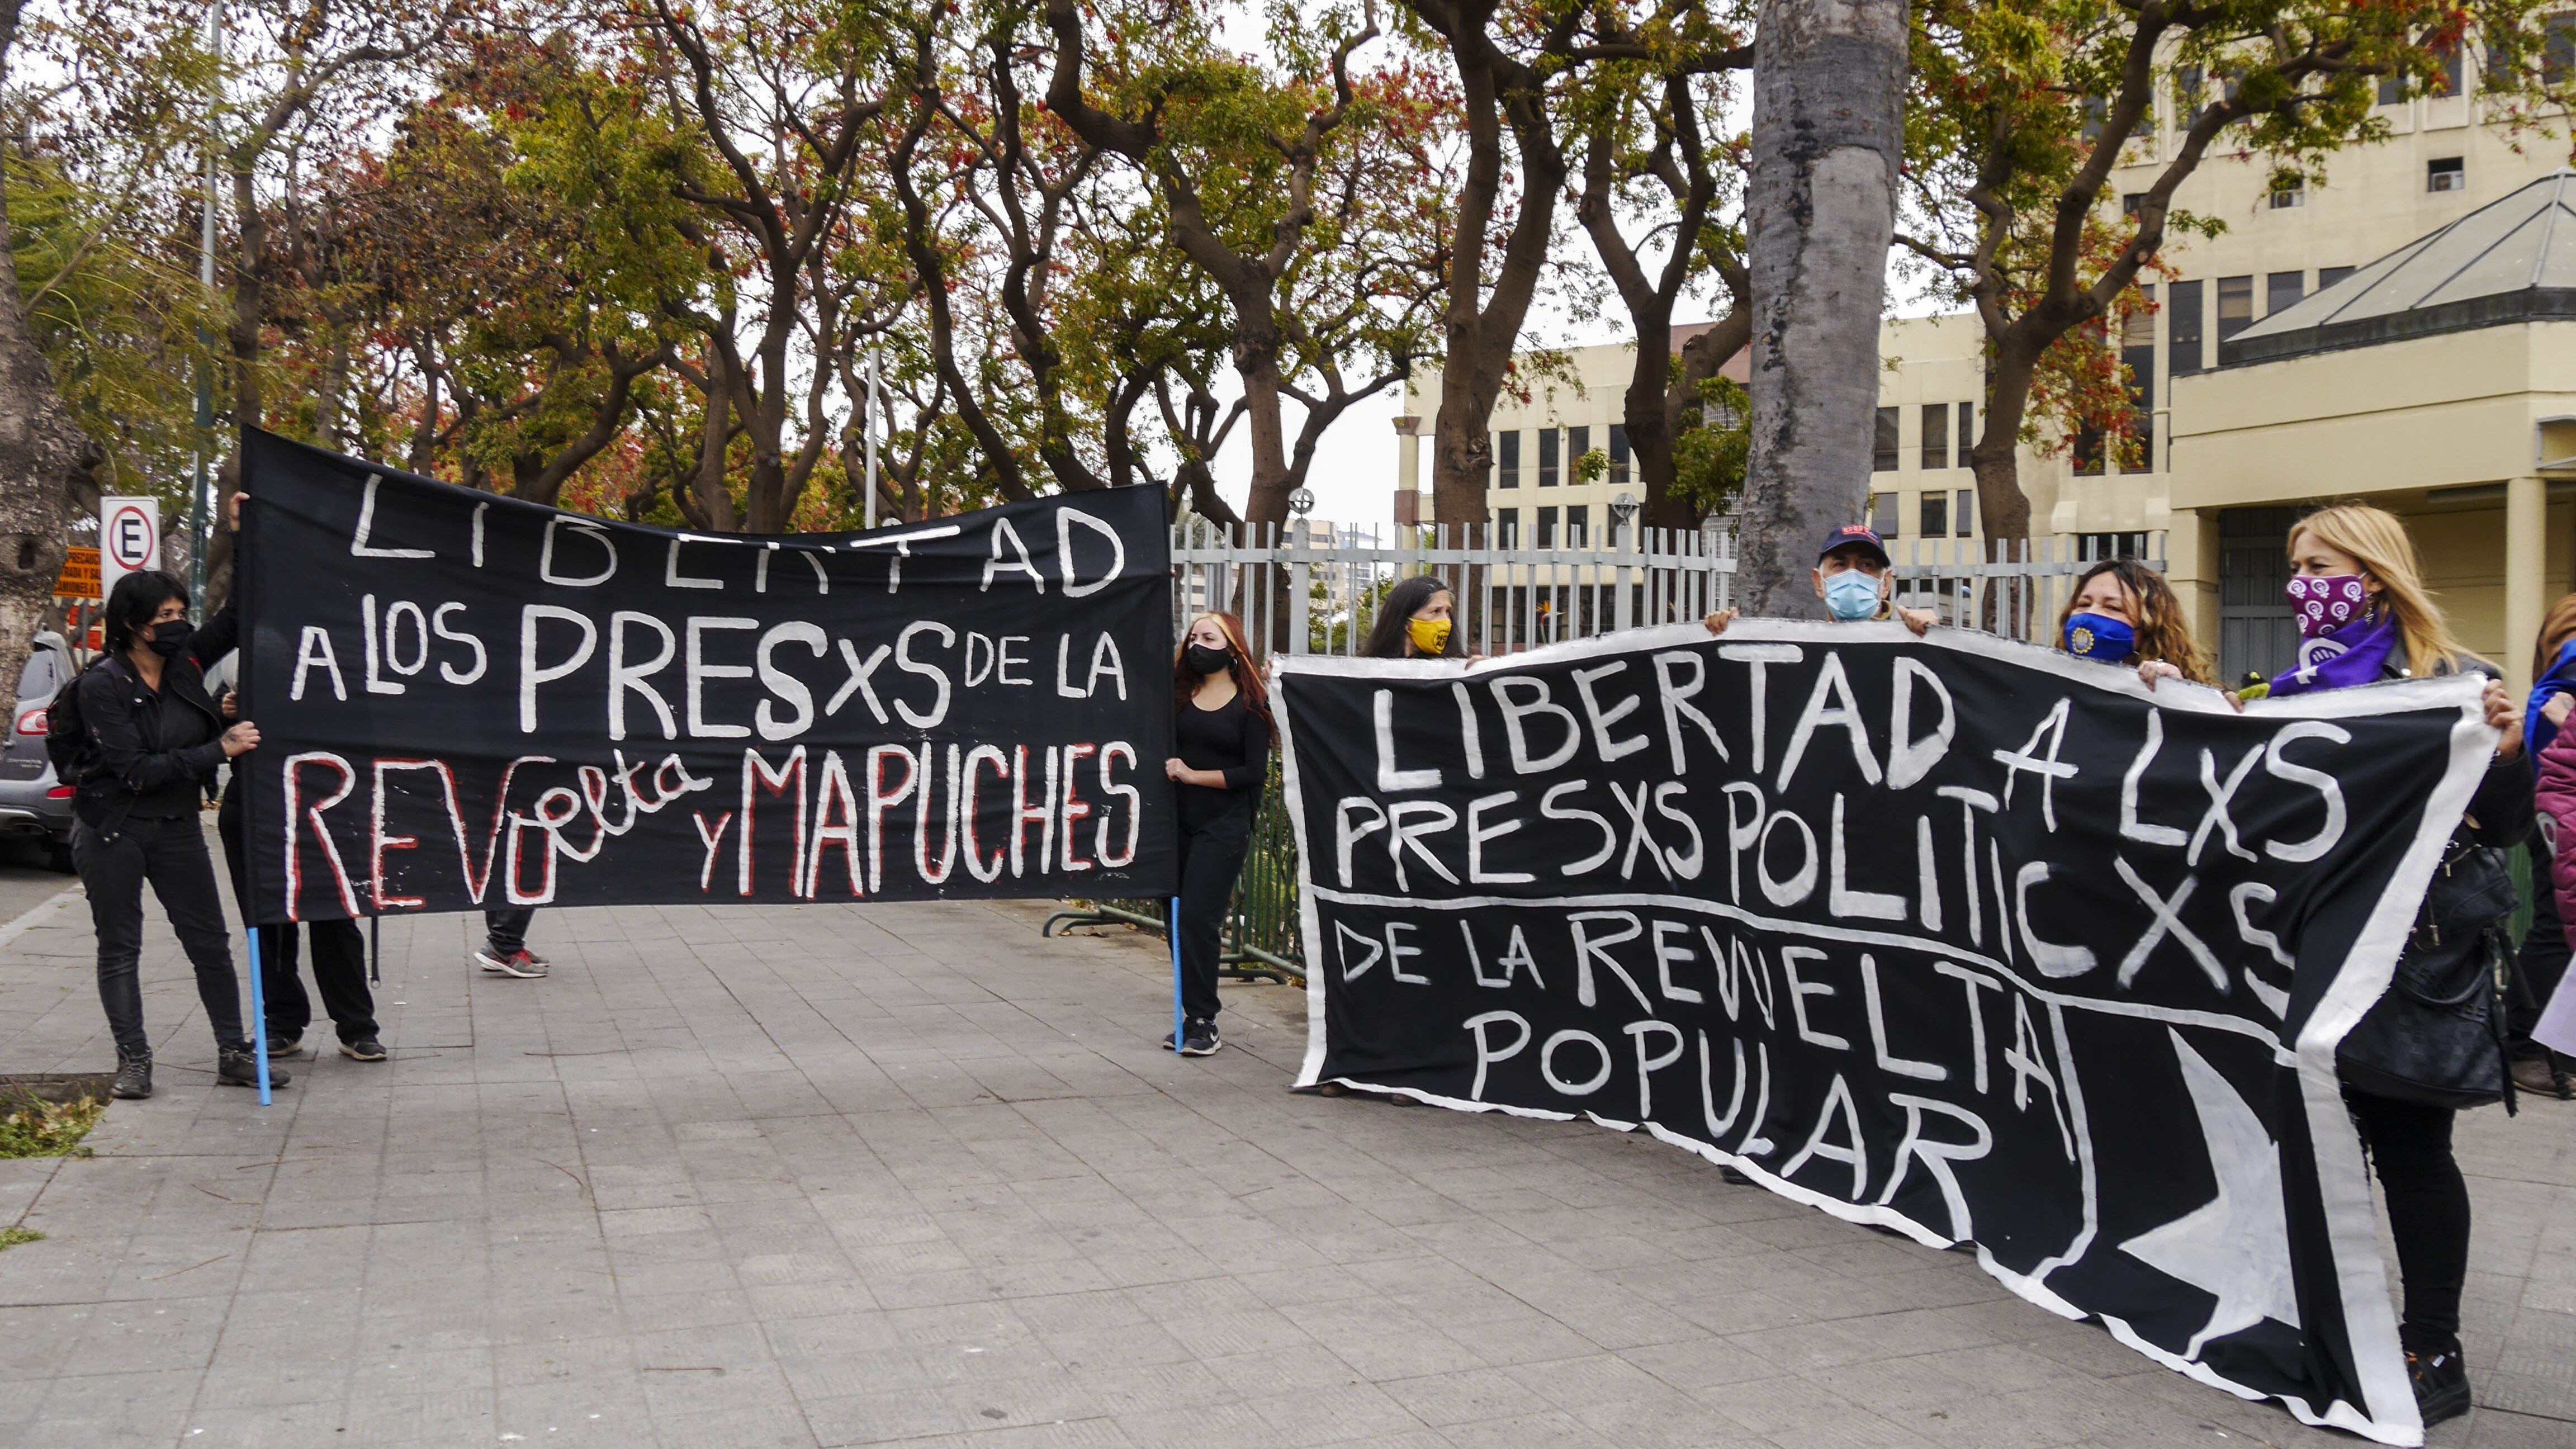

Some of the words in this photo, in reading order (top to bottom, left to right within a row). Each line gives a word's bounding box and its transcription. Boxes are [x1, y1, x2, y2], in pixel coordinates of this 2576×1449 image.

[121, 519, 143, 558] E
[291, 626, 348, 700] A
[362, 593, 487, 695] LOS
[519, 603, 955, 742] PRESXS
[965, 631, 1033, 688] DE
[1057, 631, 1127, 701] LA
[738, 741, 1142, 899] MAPUCHES
[1373, 643, 1957, 794] LIBERTAD
[1992, 696, 2080, 833] A
[2119, 707, 2352, 867] LXS
[1336, 779, 1704, 894] PRESXS
[1334, 919, 1432, 985] DE
[1460, 919, 1547, 991] LA
[1463, 1010, 1993, 1242] POPULAR
